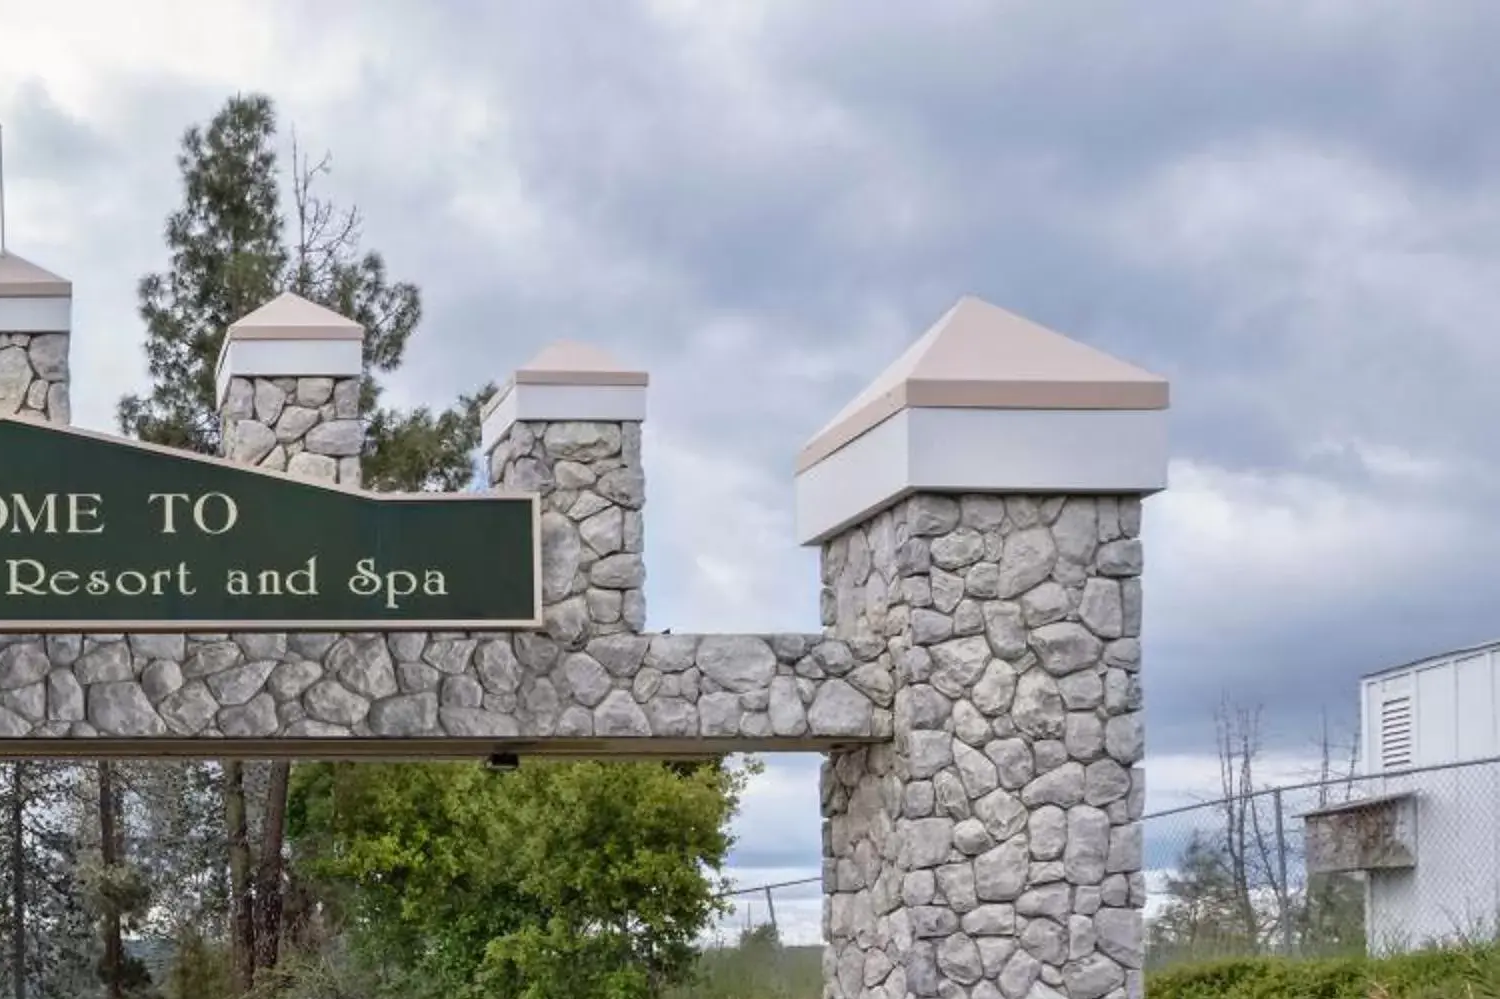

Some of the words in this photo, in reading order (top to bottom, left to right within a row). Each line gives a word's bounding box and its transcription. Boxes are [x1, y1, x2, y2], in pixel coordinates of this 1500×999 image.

[148, 491, 238, 536] TO
[5, 558, 197, 596] Resort
[226, 555, 319, 596] and
[348, 557, 448, 609] Spa
